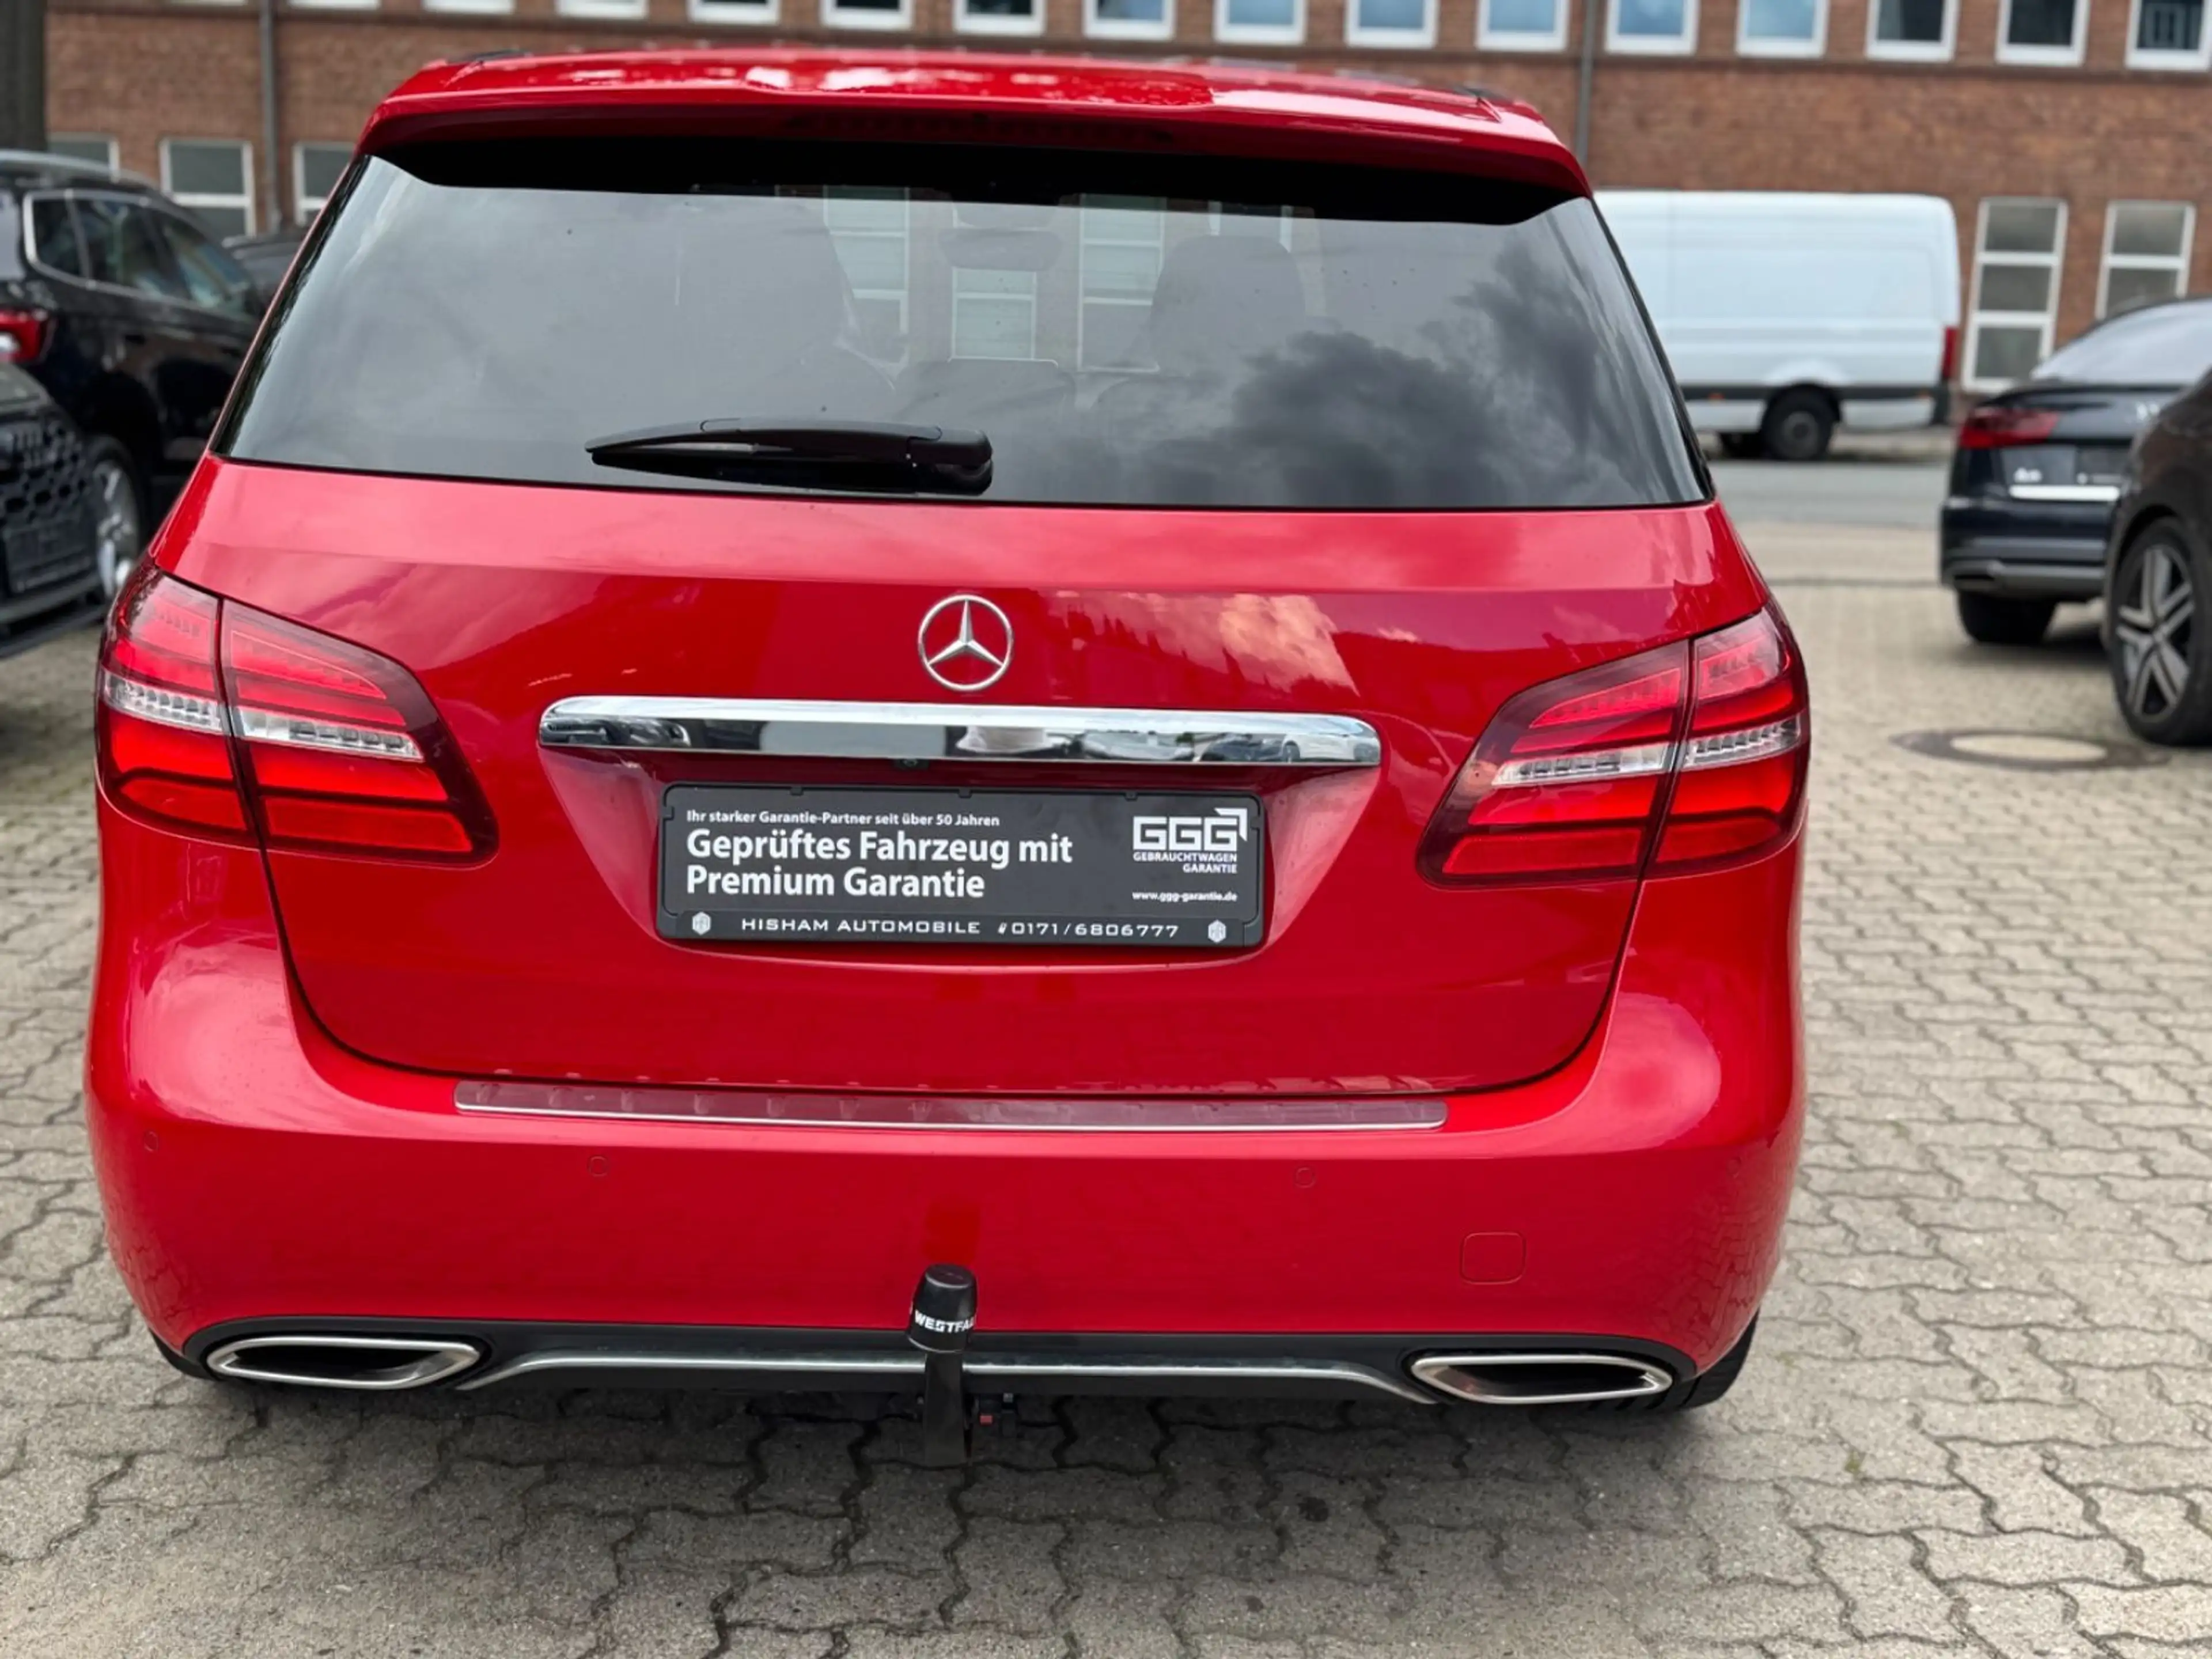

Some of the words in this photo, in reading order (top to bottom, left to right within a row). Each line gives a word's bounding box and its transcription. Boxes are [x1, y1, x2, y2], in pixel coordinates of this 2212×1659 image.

[687, 810, 706, 823] Ihr
[709, 810, 756, 823] starker
[759, 811, 872, 825] Garantie-Partner
[875, 813, 899, 825] seit
[902, 812, 933, 826] über
[936, 815, 952, 826] 50
[955, 815, 1000, 827] Jahren
[1132, 816, 1237, 851] GGG
[687, 828, 851, 865] Geprüftes
[859, 830, 1010, 870] Fahrzeug
[1018, 832, 1073, 863] mit
[1132, 852, 1237, 863] GEBRAUCHTWAGEN
[1183, 863, 1237, 873] GARANTIE
[687, 865, 835, 896] Premium
[843, 867, 985, 897] Garantie
[1132, 891, 1237, 903] www.ggg-garantie.de
[741, 918, 829, 931] HISHAM
[836, 919, 980, 934] AUTOMOBILE
[1011, 922, 1179, 937] 0171/6806777
